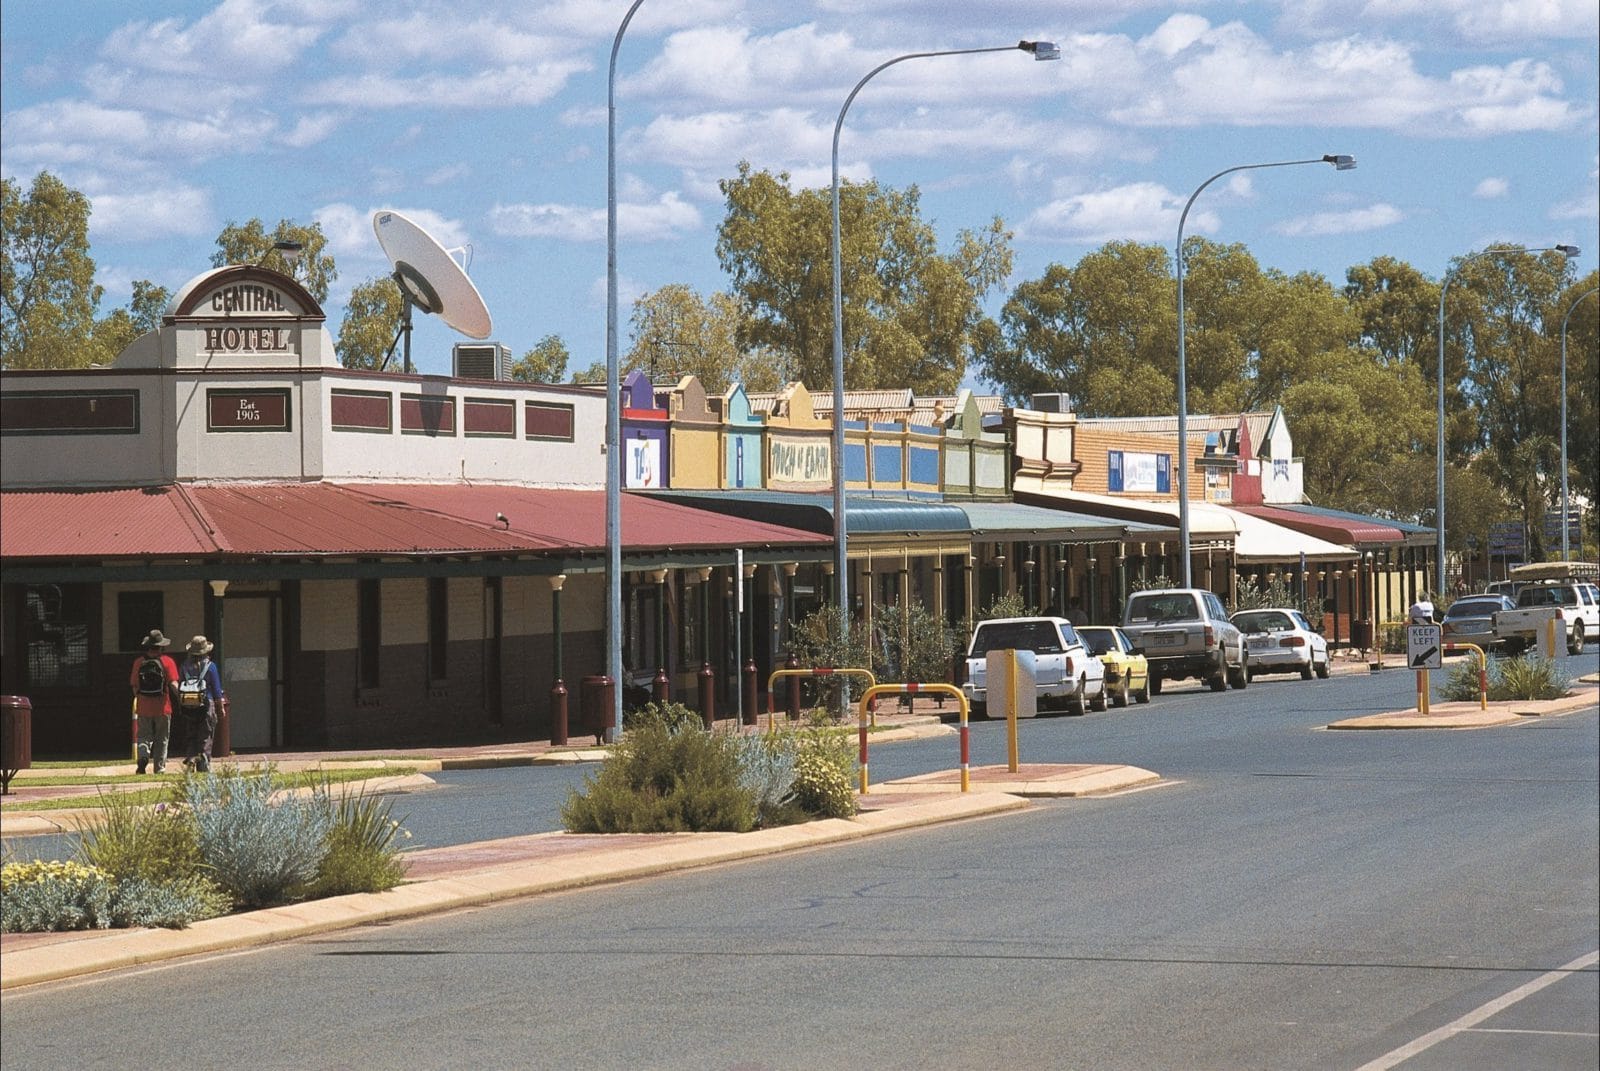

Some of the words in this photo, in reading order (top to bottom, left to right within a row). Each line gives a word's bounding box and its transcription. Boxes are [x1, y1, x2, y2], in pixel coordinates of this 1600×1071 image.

[212, 285, 285, 312] CENTRAL
[204, 327, 287, 352] HOTEL
[240, 399, 255, 410] Est
[235, 410, 260, 420] 1905
[771, 442, 796, 479] TOUCH
[804, 445, 829, 479] EARTH
[1412, 628, 1435, 636] KEEP
[1413, 637, 1434, 645] LEFT
